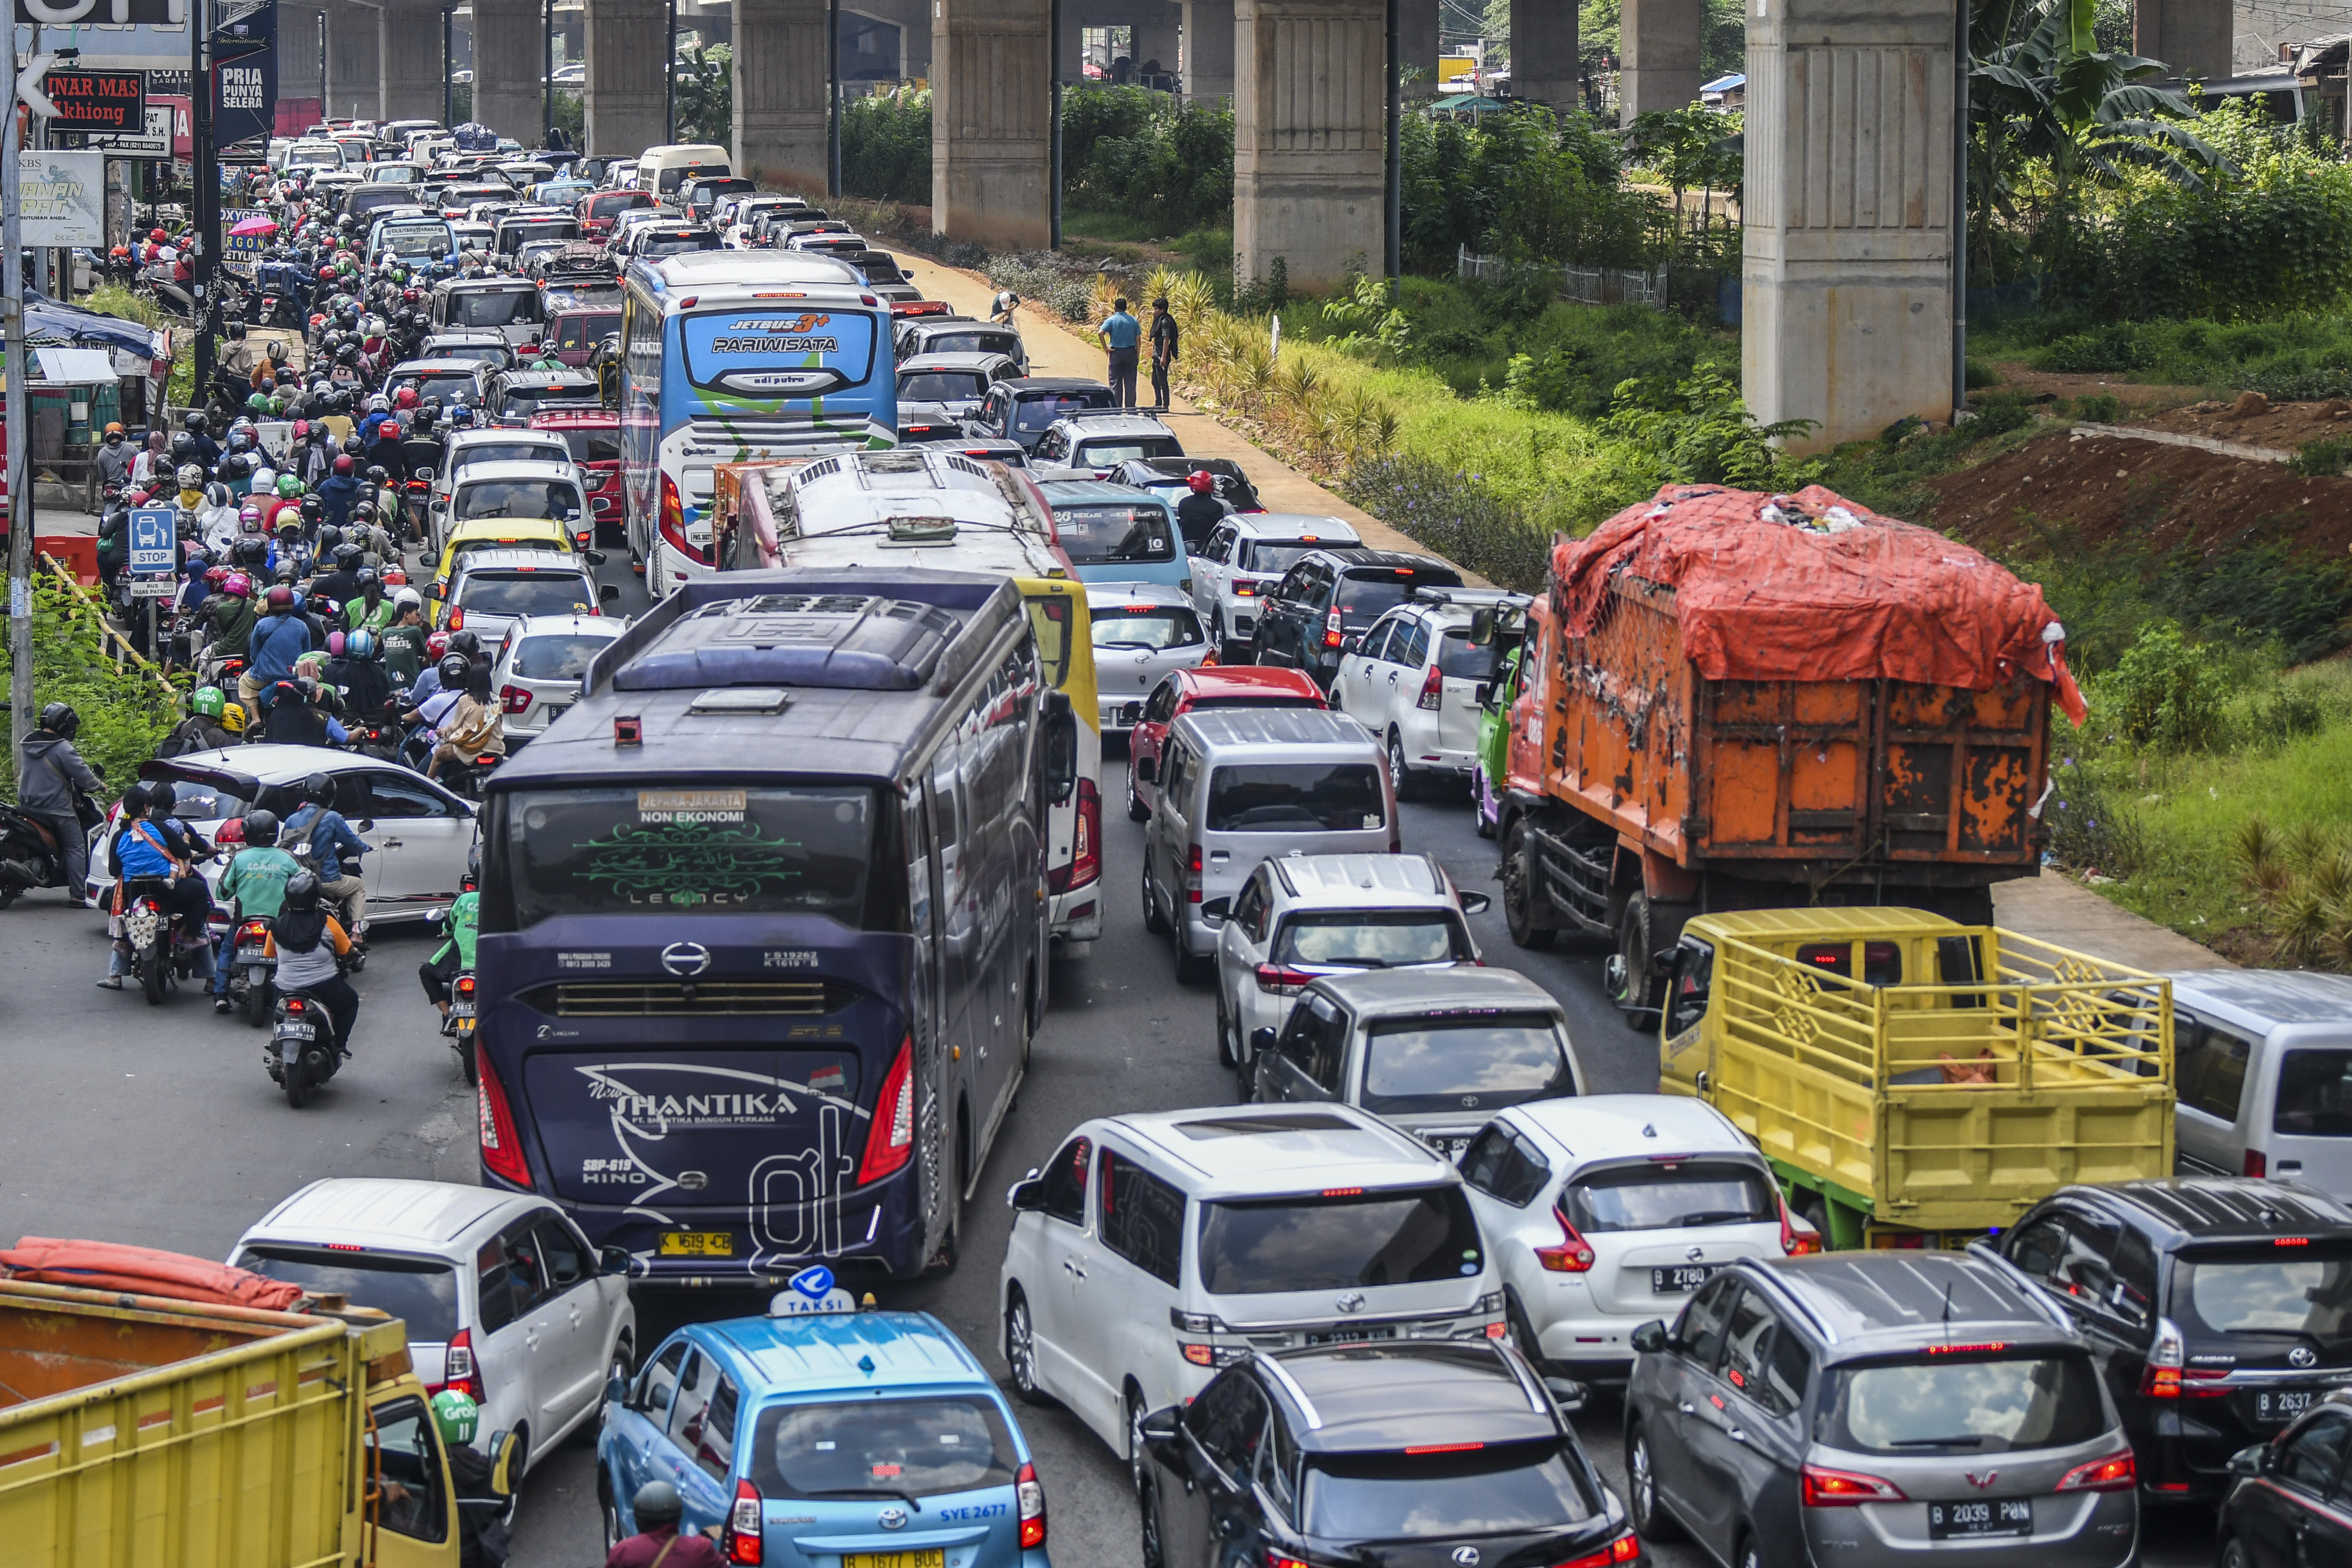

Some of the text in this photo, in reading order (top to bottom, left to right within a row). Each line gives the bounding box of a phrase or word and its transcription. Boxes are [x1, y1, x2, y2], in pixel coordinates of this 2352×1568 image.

[217, 36, 266, 44] International
[223, 68, 263, 85] PRIA
[99, 79, 138, 97] MAS
[223, 85, 263, 97] PUNYA
[223, 97, 263, 108] SELERA
[729, 320, 797, 330] JETBUS
[711, 337, 838, 353] PARIWISATA
[774, 376, 804, 385] putra
[285, 482, 299, 490] Grab
[1053, 511, 1071, 522] 26
[139, 553, 167, 561] STOP
[196, 693, 218, 703] Grab
[552, 707, 556, 716] B
[641, 811, 744, 823] NON EKONOMI
[588, 1081, 623, 1099] New
[610, 1093, 798, 1116] SHANTIKA
[583, 1159, 632, 1171] SBP-619
[583, 1173, 646, 1183] HINO
[1655, 1268, 1705, 1285] B 2780
[789, 1300, 842, 1312] TAKSI
[2261, 1393, 2312, 1410] B 2637
[444, 1403, 477, 1420] Grab
[941, 1504, 1007, 1522] SYE 2677
[1933, 1506, 1943, 1523] B
[1953, 1504, 1990, 1522] 2039
[871, 1555, 903, 1568] 1677
[914, 1554, 941, 1568] BUC
